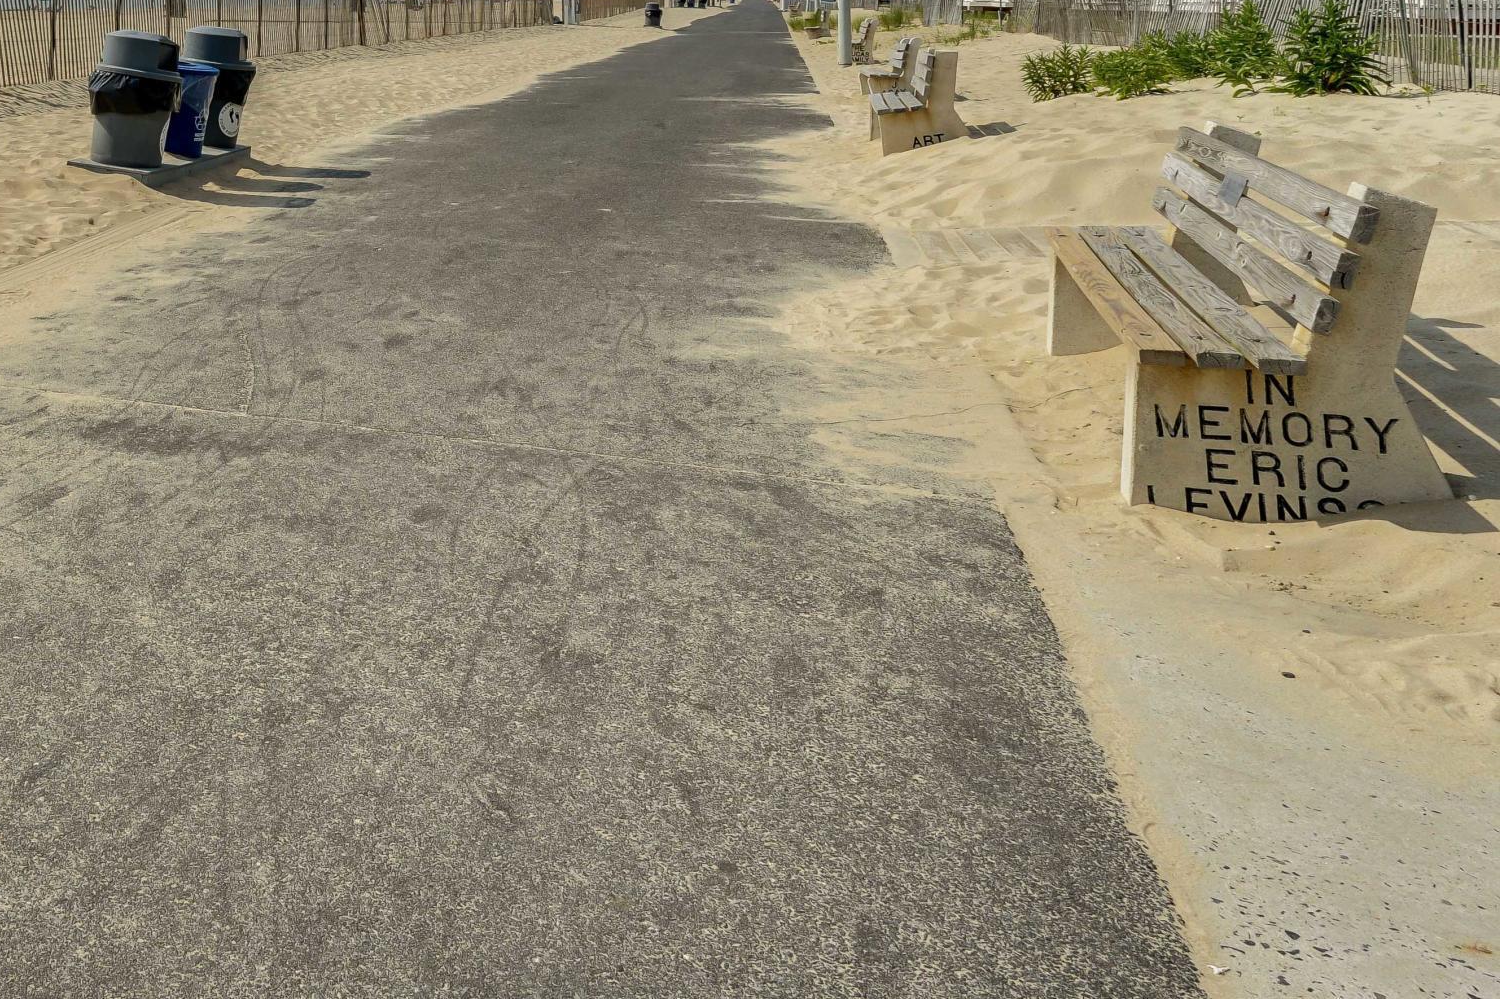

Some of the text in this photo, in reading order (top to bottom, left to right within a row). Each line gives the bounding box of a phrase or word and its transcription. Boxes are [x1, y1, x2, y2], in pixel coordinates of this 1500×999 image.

[1245, 369, 1296, 407] IN
[1154, 404, 1400, 454] MEMORY
[1206, 448, 1351, 493] ERIC
